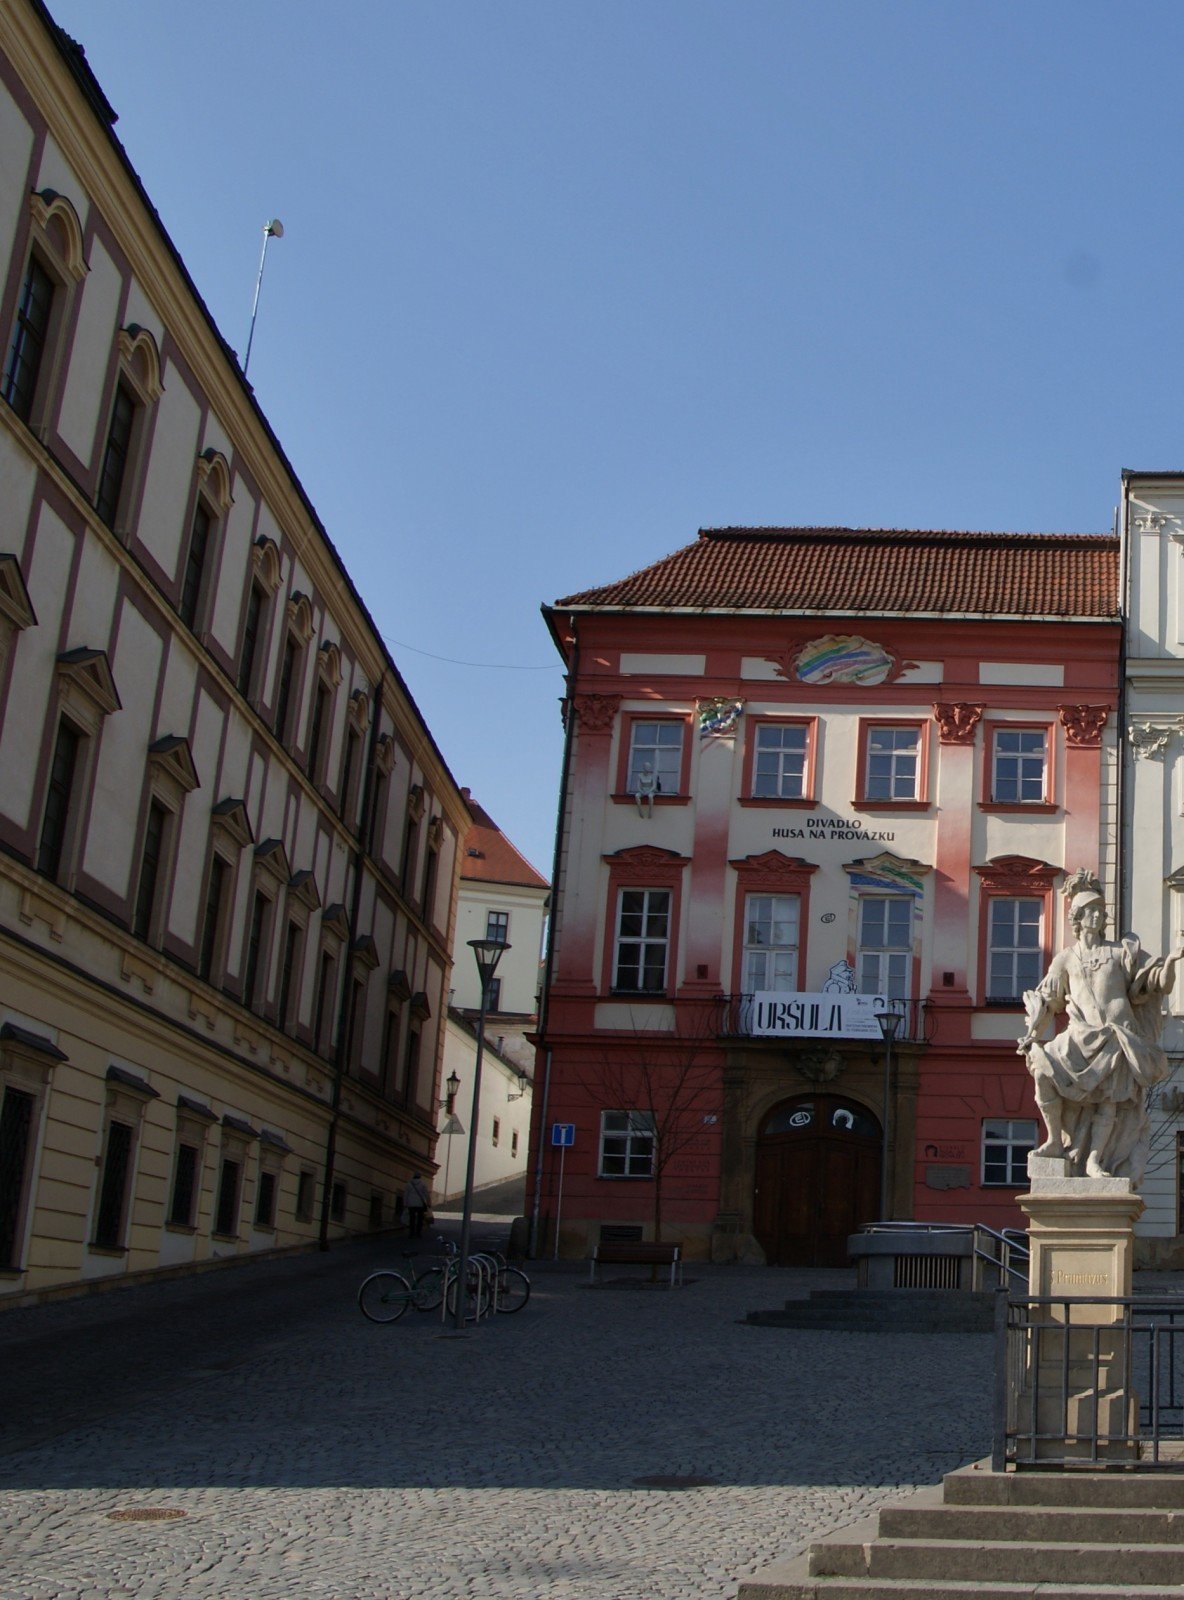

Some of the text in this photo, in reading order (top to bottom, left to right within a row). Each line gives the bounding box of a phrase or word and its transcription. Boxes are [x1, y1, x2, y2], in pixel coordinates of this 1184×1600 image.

[806, 818, 862, 829] DIVADLO
[772, 828, 896, 842] HUSA NA PROVÁZKU
